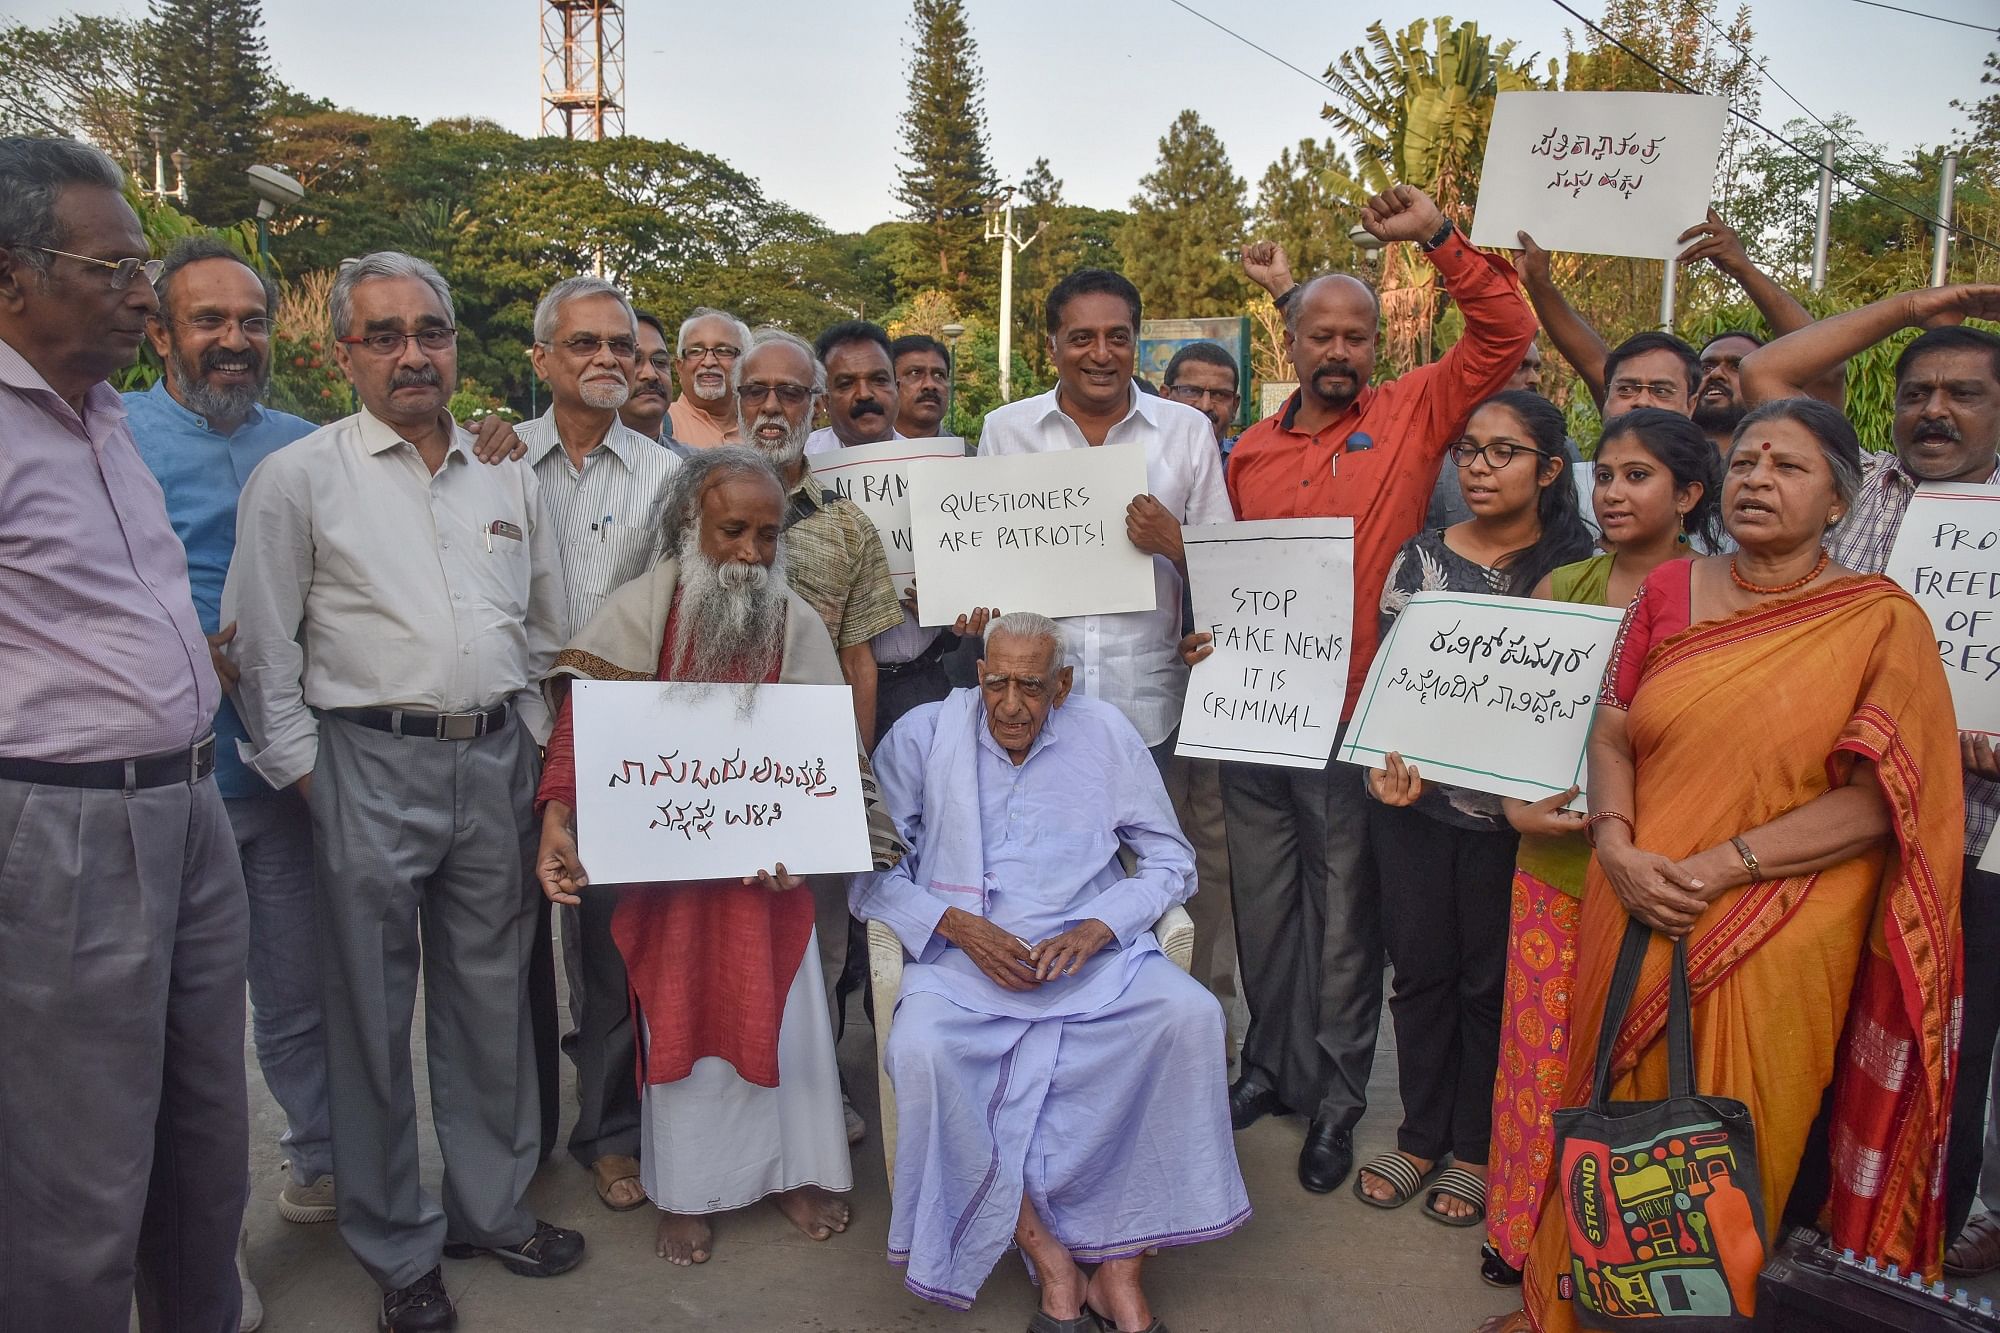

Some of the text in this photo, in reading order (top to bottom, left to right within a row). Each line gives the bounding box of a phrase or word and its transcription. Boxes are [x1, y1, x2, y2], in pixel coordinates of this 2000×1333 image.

[940, 487, 1090, 520] QUESTIONERS
[939, 520, 1105, 551] ARE PATRIOTS!
[1932, 523, 2000, 550] PRO
[1232, 587, 1297, 617] STOP
[1945, 611, 1993, 637] OF
[1211, 624, 1342, 661] FAKE NEWS
[1244, 667, 1286, 692] IT IS
[1203, 691, 1321, 732] CRIMINAL
[1583, 1159, 1600, 1242] STRAND
